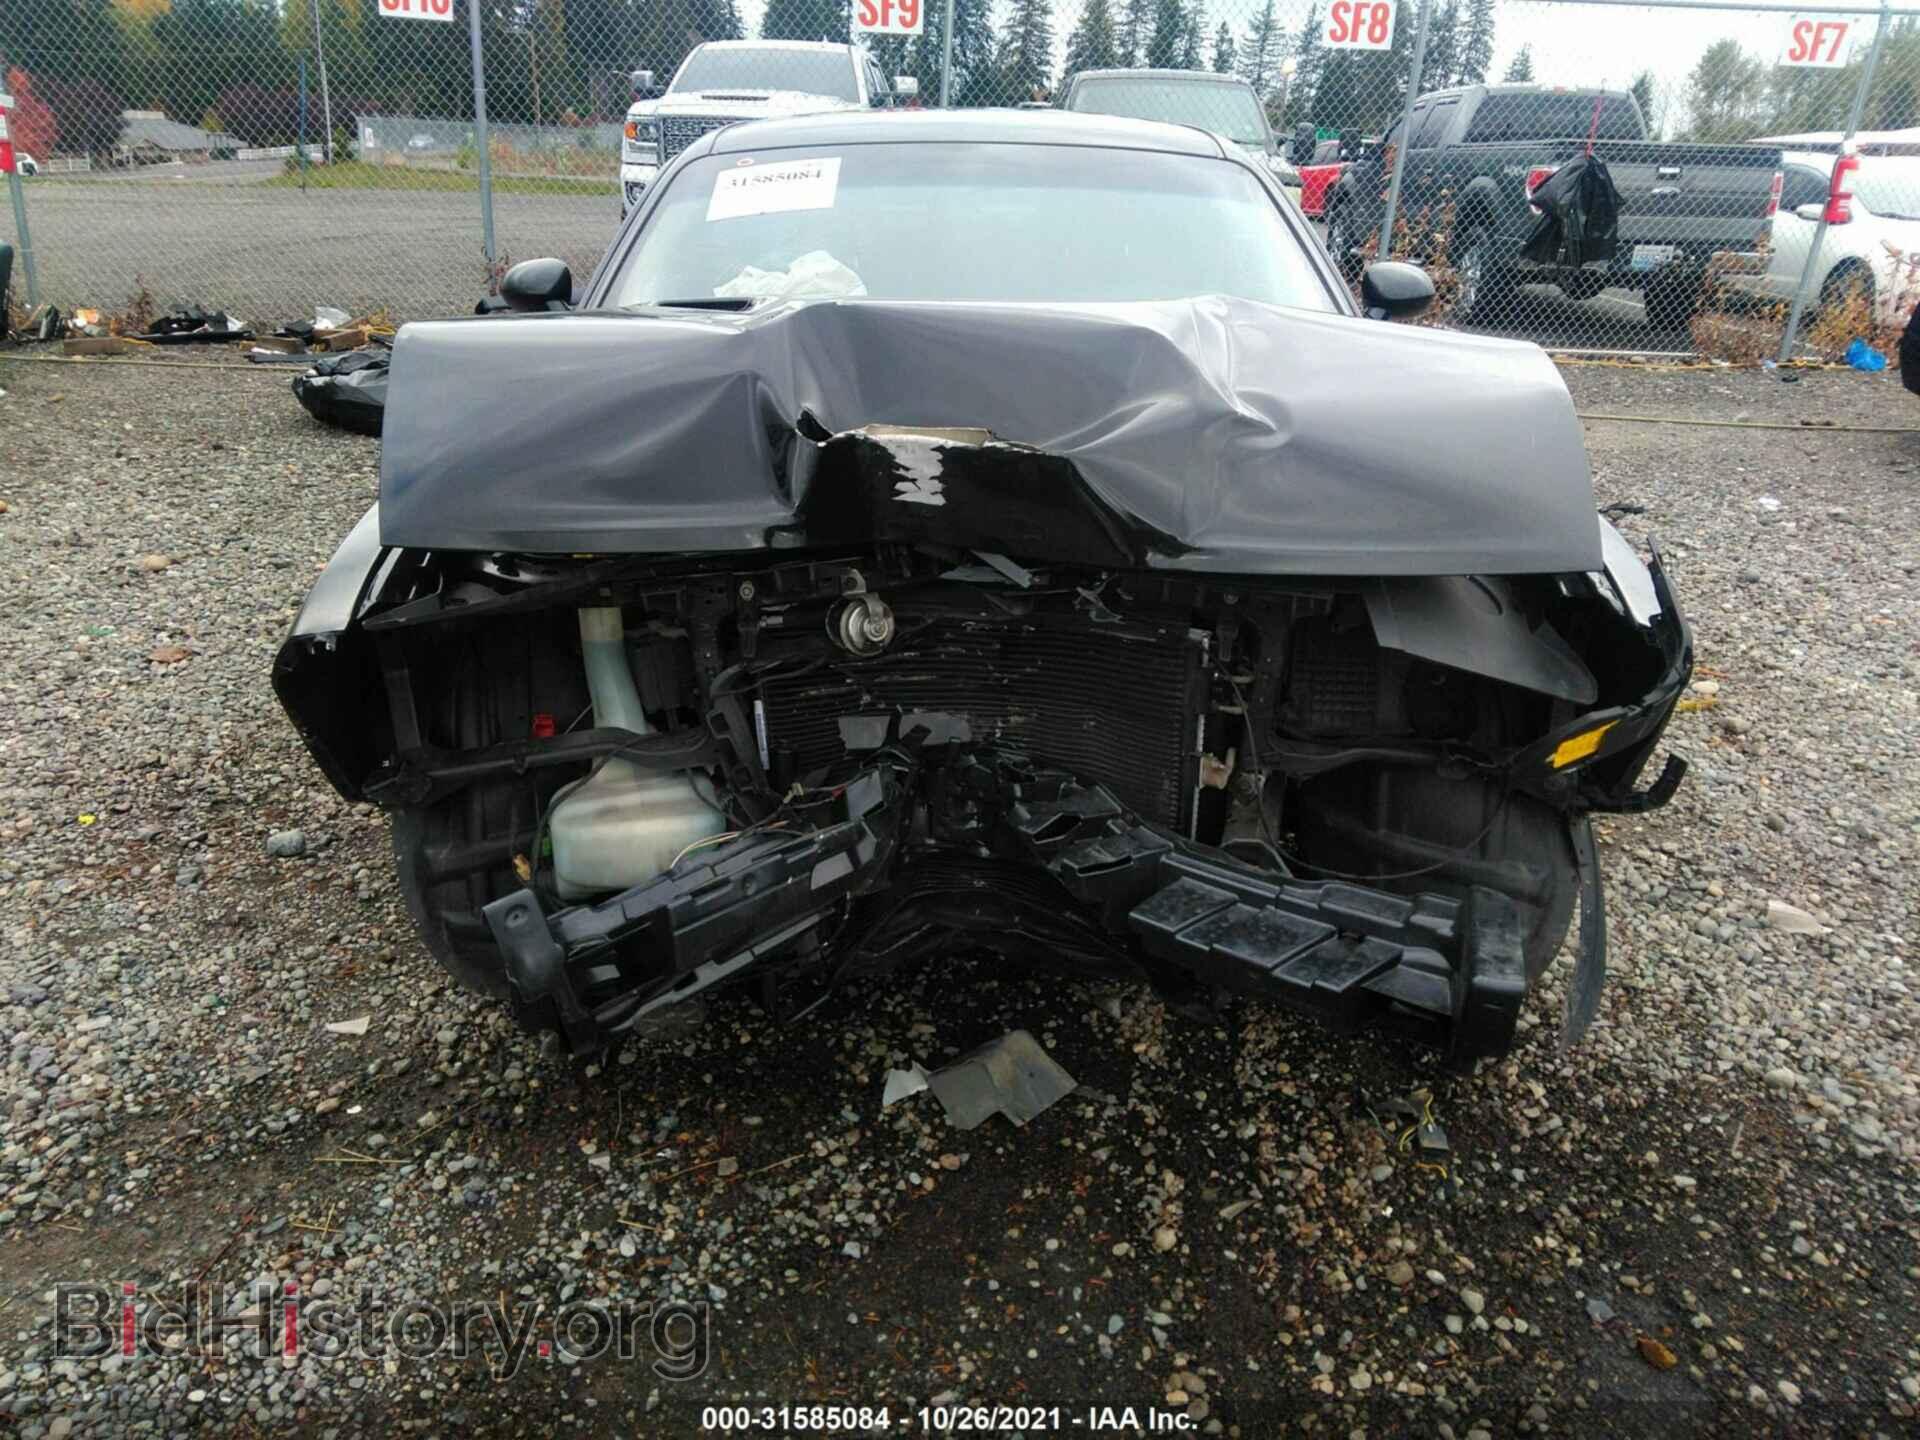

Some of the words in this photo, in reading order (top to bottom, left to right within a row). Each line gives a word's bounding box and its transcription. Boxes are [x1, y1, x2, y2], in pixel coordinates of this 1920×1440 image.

[858, 0, 919, 28] SF9
[1329, 1, 1390, 43] SF8
[1788, 20, 1848, 61] SF7
